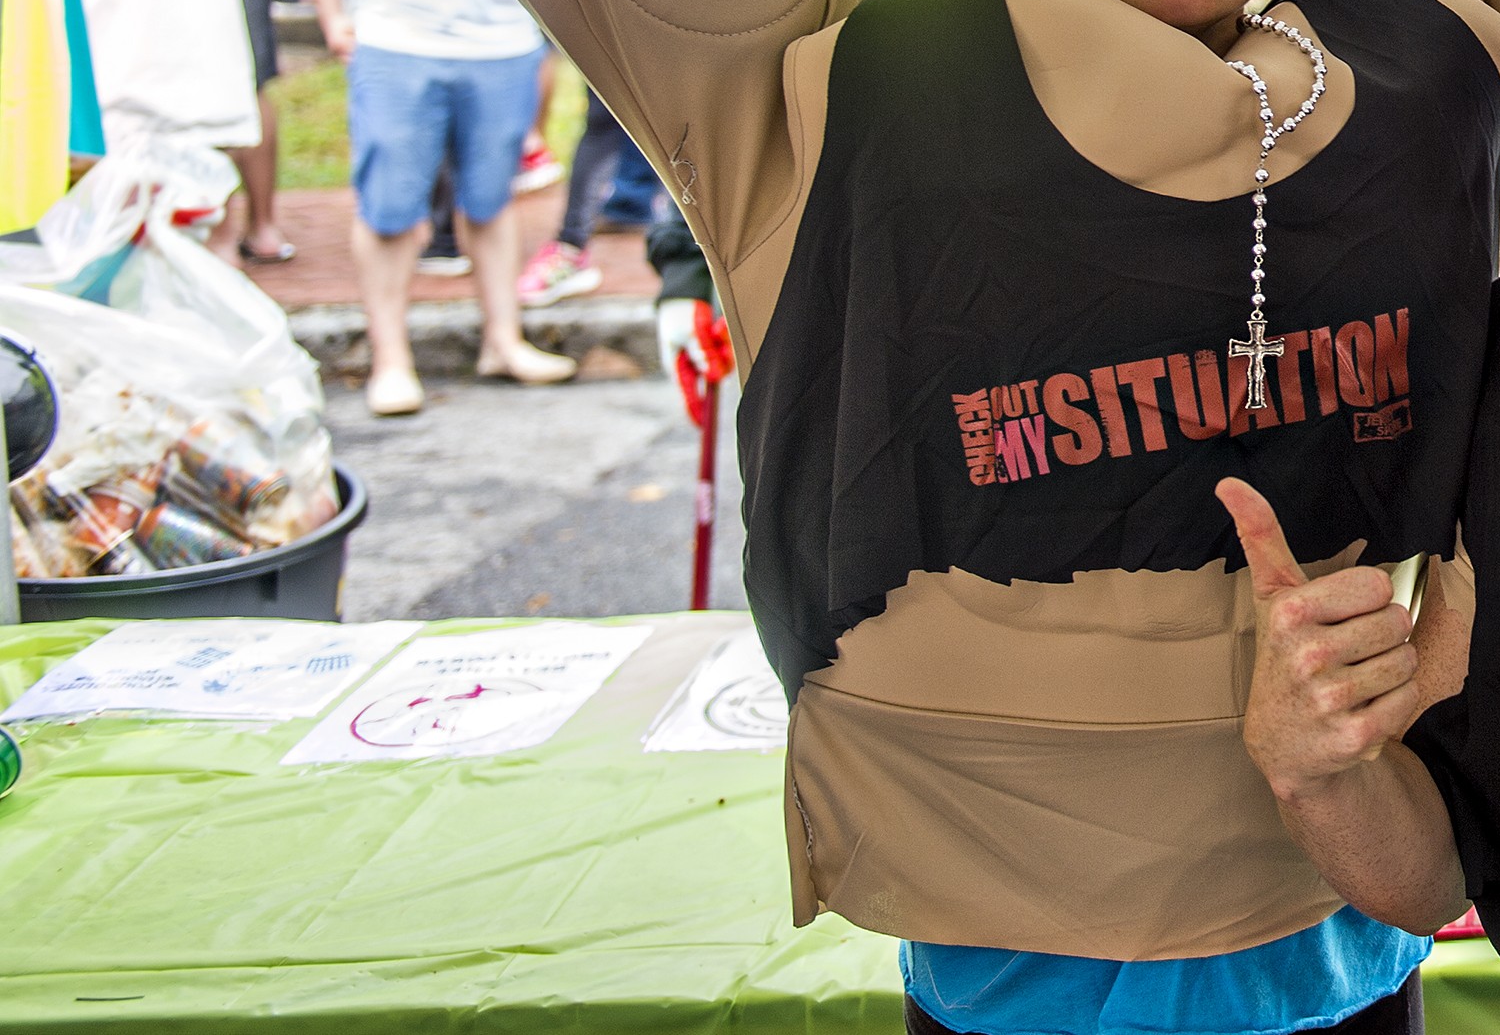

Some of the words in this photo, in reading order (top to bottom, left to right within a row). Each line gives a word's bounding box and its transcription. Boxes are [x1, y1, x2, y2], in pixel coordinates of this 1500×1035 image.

[951, 388, 997, 486] CHECK
[990, 379, 1040, 421] OUT
[993, 414, 1050, 484] MY
[1042, 308, 1410, 465] SITUATION
